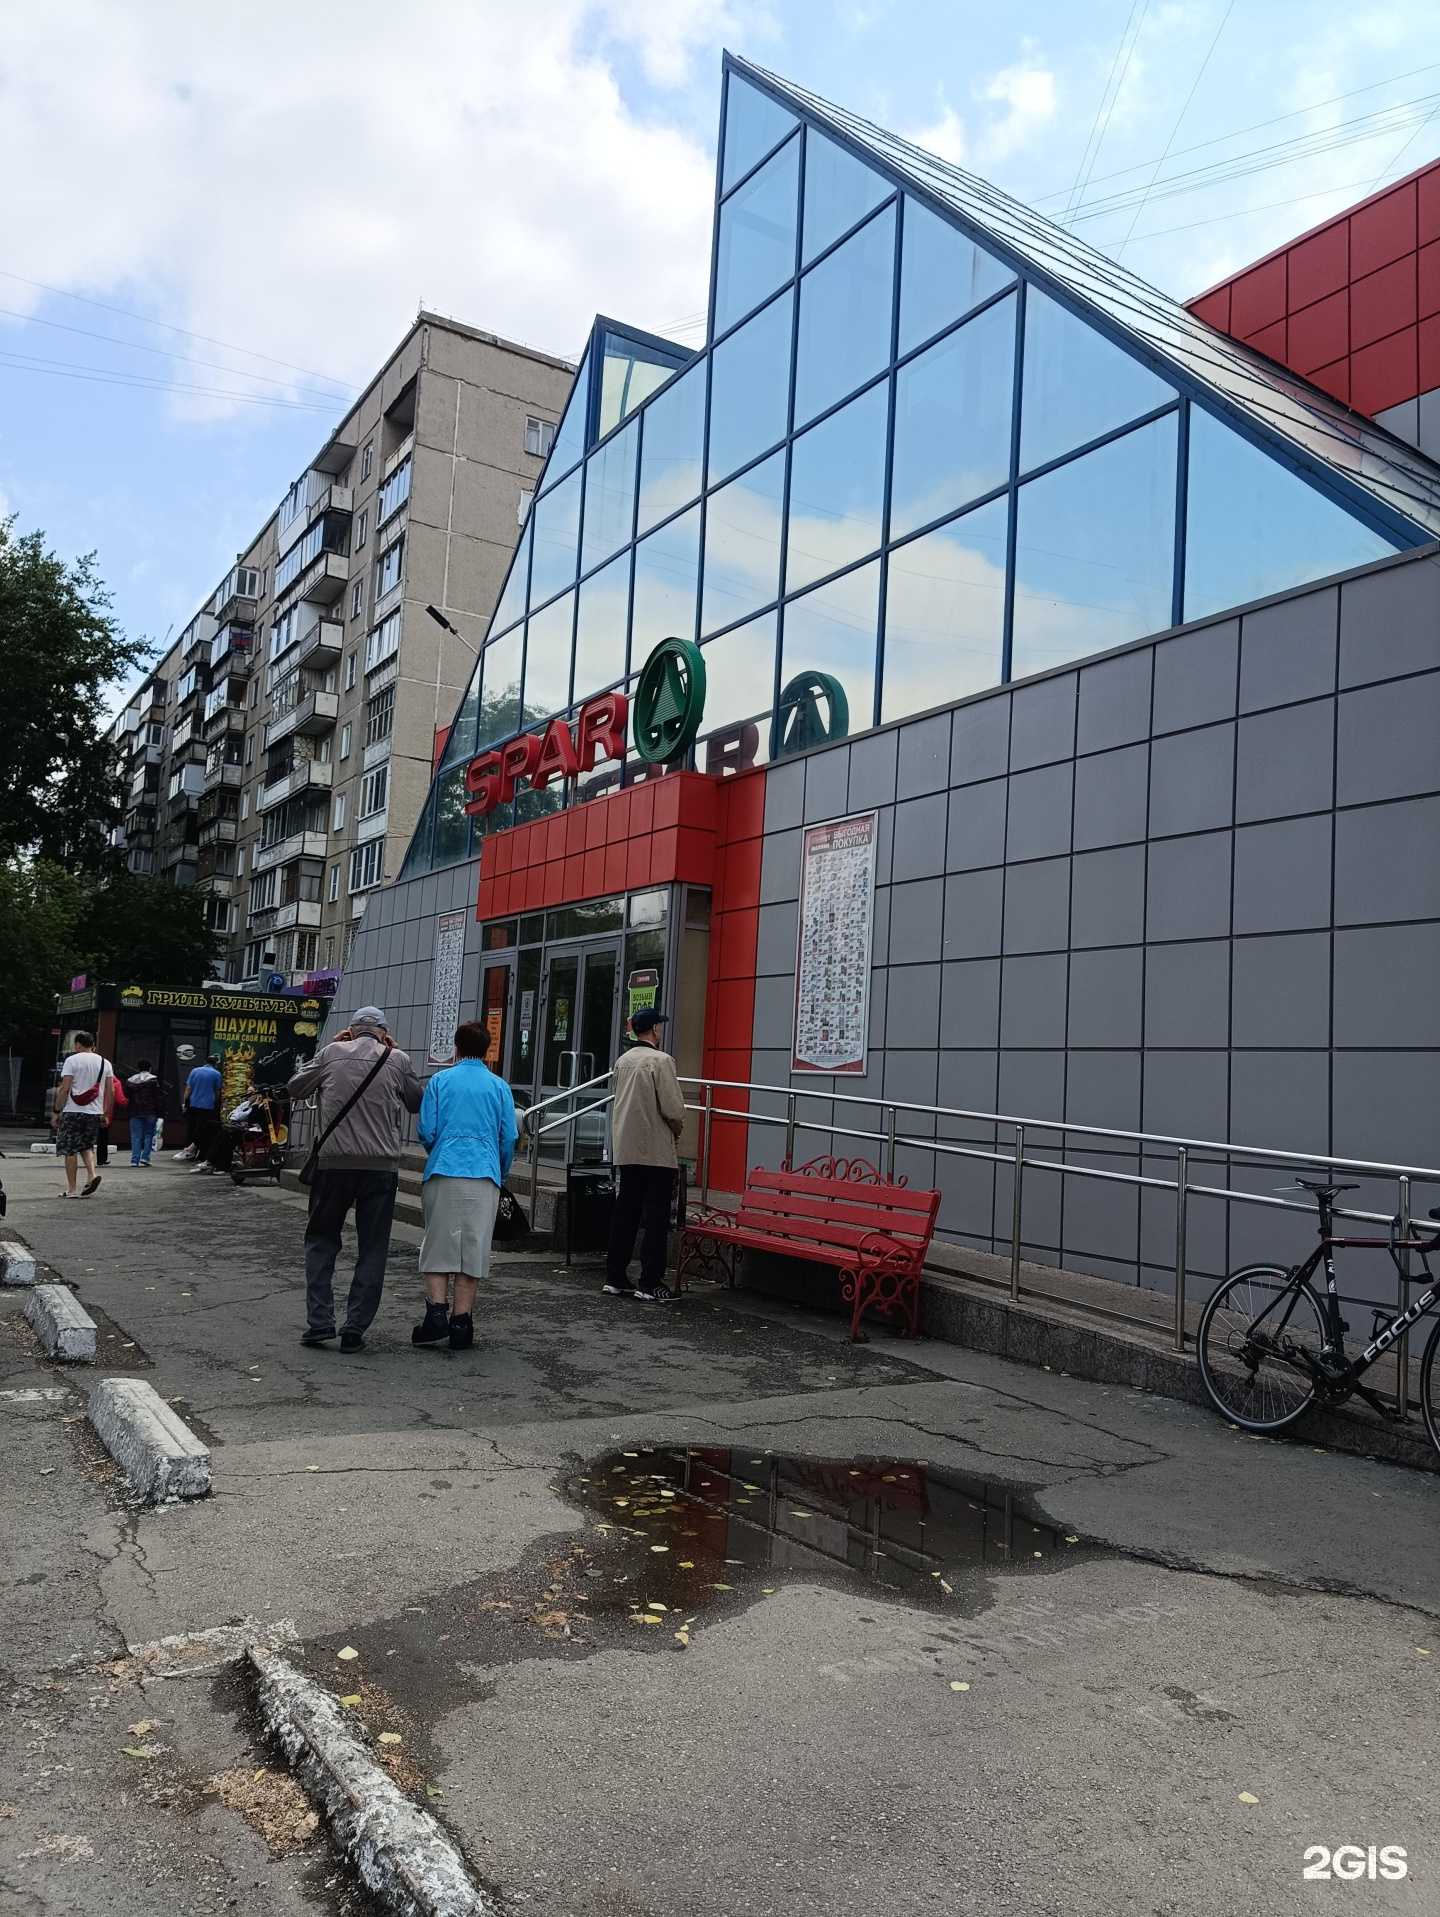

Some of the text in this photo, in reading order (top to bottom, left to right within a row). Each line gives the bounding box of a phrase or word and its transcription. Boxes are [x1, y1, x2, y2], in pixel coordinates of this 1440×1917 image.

[465, 692, 628, 816] SPAR
[832, 834, 869, 850] ПОКУПКА
[147, 990, 207, 1008] ГРИЛЬ
[211, 994, 298, 1013] КУЛЬТУРА
[214, 1016, 277, 1035] ШАУРМА
[1364, 1290, 1437, 1363] FOCUS
